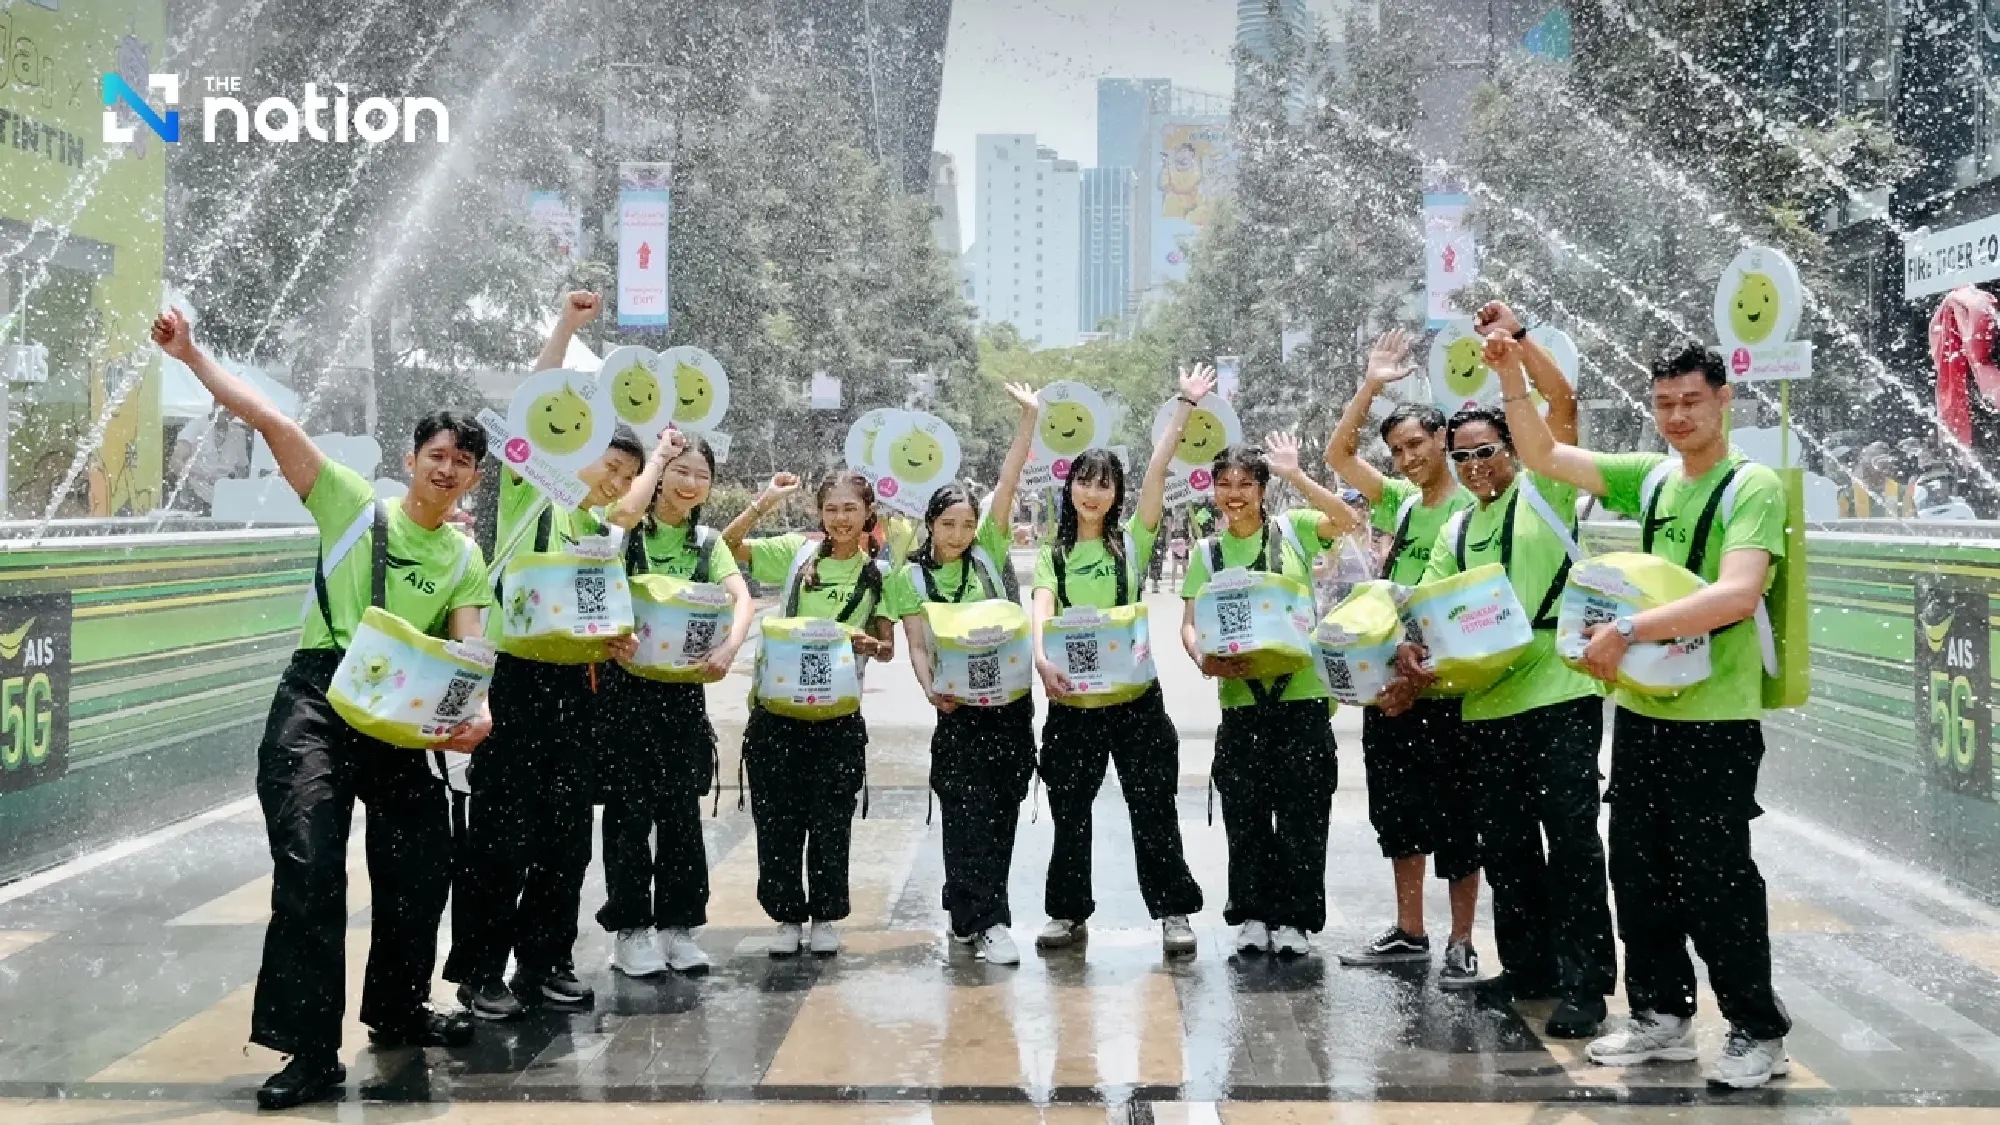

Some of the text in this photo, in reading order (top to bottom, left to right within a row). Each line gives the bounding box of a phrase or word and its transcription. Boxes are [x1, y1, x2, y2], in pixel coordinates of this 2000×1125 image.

[1665, 526, 1686, 544] AS
[404, 570, 436, 595] AIS
[827, 588, 854, 603] AIS
[23, 636, 54, 668] AIS
[1947, 637, 1974, 669] AIS
[0, 672, 52, 772] 5G
[1930, 671, 1976, 772] 5G
